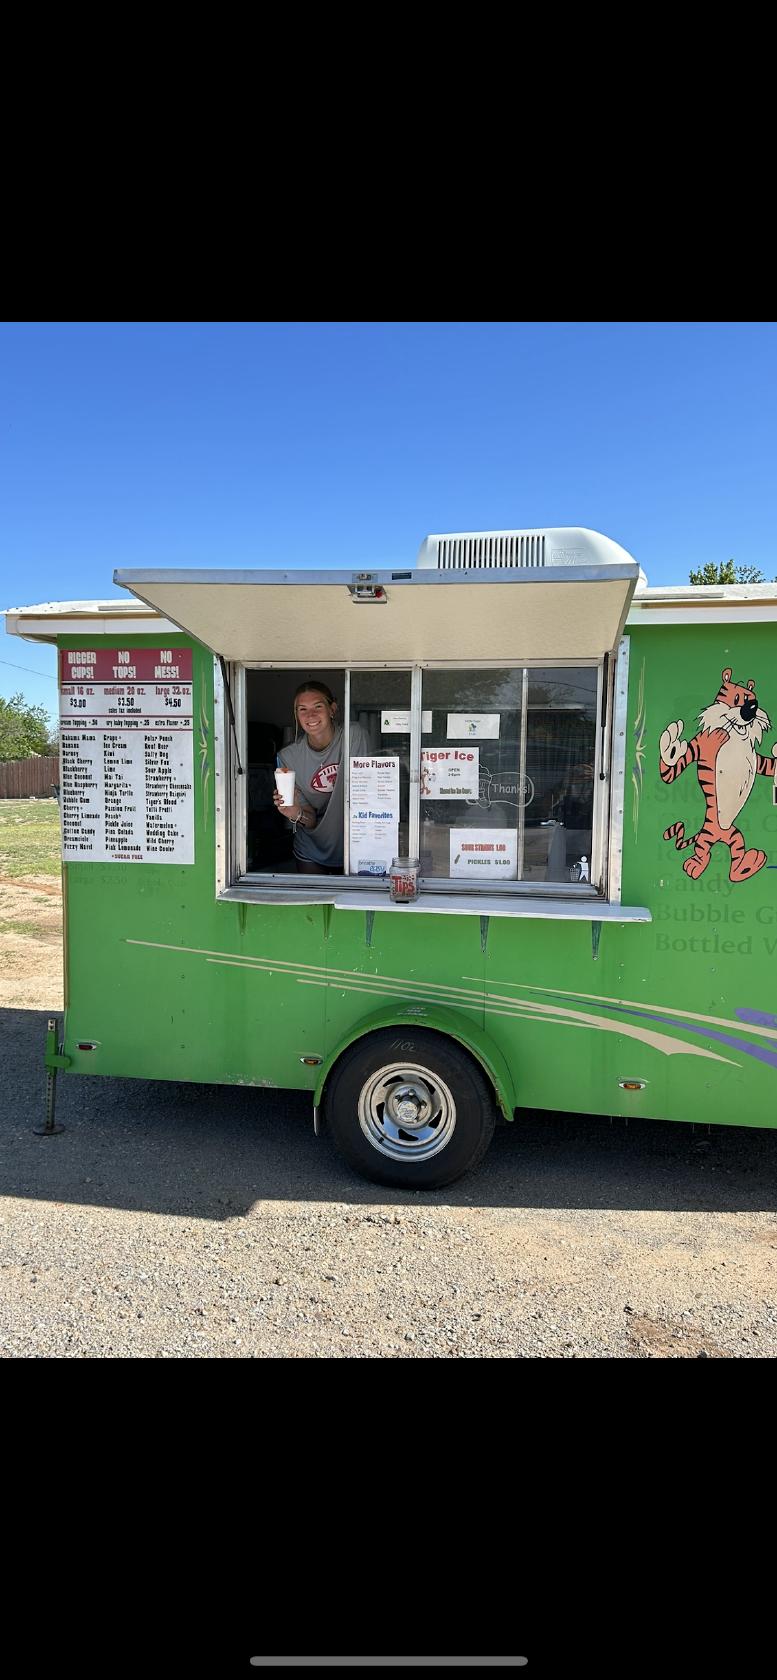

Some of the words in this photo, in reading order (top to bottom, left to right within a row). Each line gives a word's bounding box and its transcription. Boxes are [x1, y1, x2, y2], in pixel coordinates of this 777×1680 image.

[68, 652, 96, 664] BIGGER
[118, 651, 130, 664] NO
[160, 651, 172, 663] NO
[71, 666, 94, 679] CUPS!
[112, 666, 136, 678] TOPS!
[154, 666, 179, 678] MESS!
[77, 686, 84, 695] 16
[86, 687, 95, 695] oz.
[104, 686, 124, 695] medium
[136, 687, 146, 695] oz.
[156, 686, 170, 697] large
[172, 686, 180, 694] 32
[182, 687, 191, 695] oz.
[70, 698, 86, 708] $3.00
[118, 698, 134, 706] $3.50
[165, 698, 181, 707] $4.50
[421, 752, 450, 762] Tiger
[455, 751, 474, 761] Ice
[371, 760, 395, 768] Flavors
[492, 784, 530, 794] Thanks!
[392, 875, 414, 896] Tips
[656, 902, 746, 924] Bubble
[656, 932, 752, 954] Bottled
